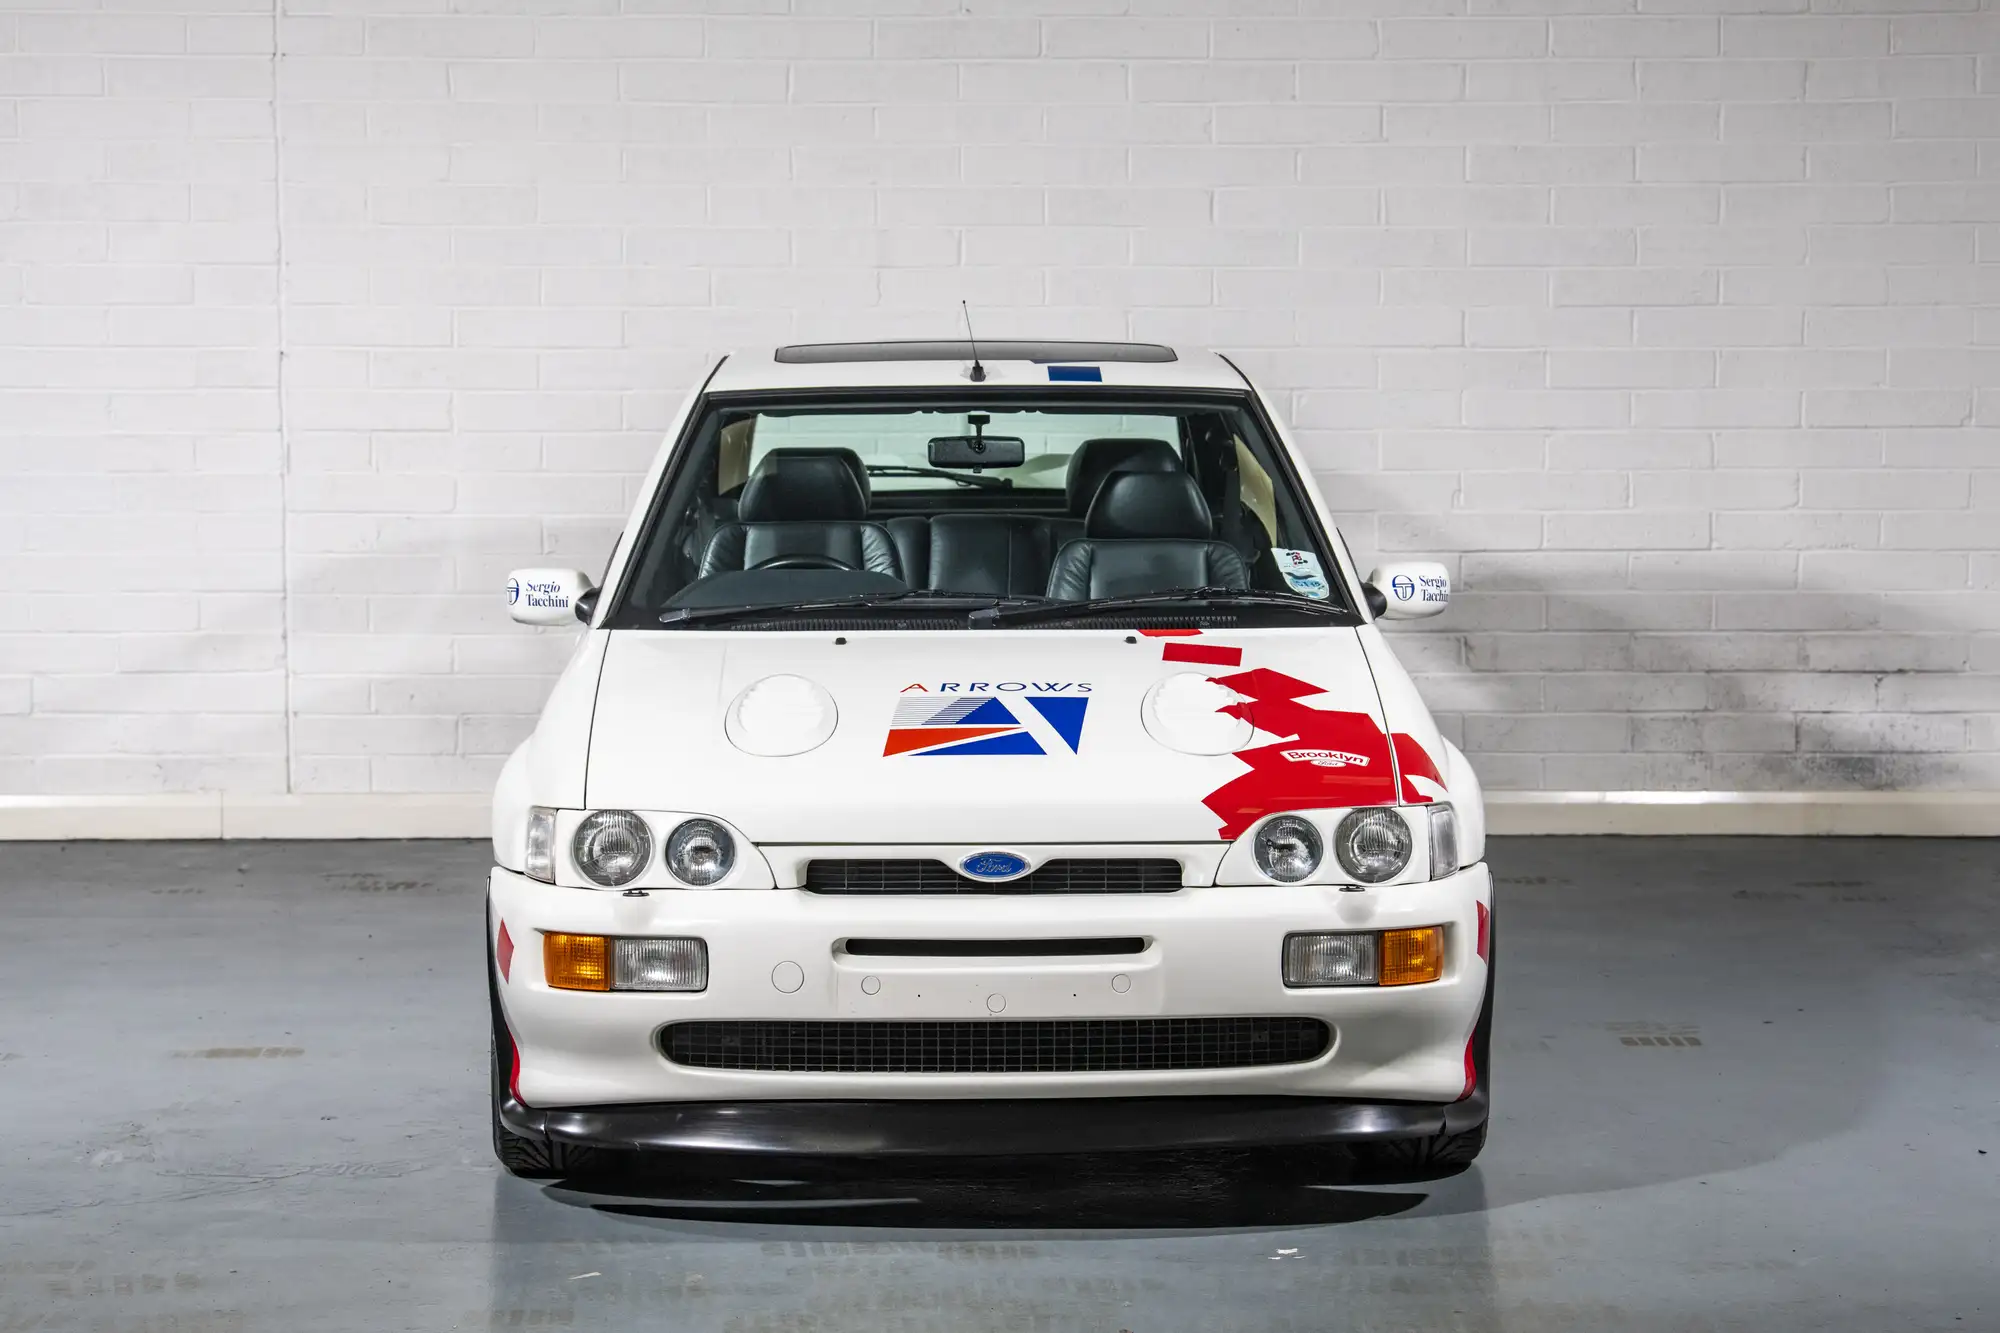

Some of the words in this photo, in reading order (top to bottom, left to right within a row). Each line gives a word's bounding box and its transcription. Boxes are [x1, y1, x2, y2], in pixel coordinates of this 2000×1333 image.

[525, 579, 561, 595] Sergio
[1418, 575, 1447, 590] Sergio
[525, 594, 569, 608] Tacchini
[900, 682, 1093, 693] ARROWS
[1287, 751, 1364, 763] Brooklyn
[976, 857, 1013, 873] Ford
